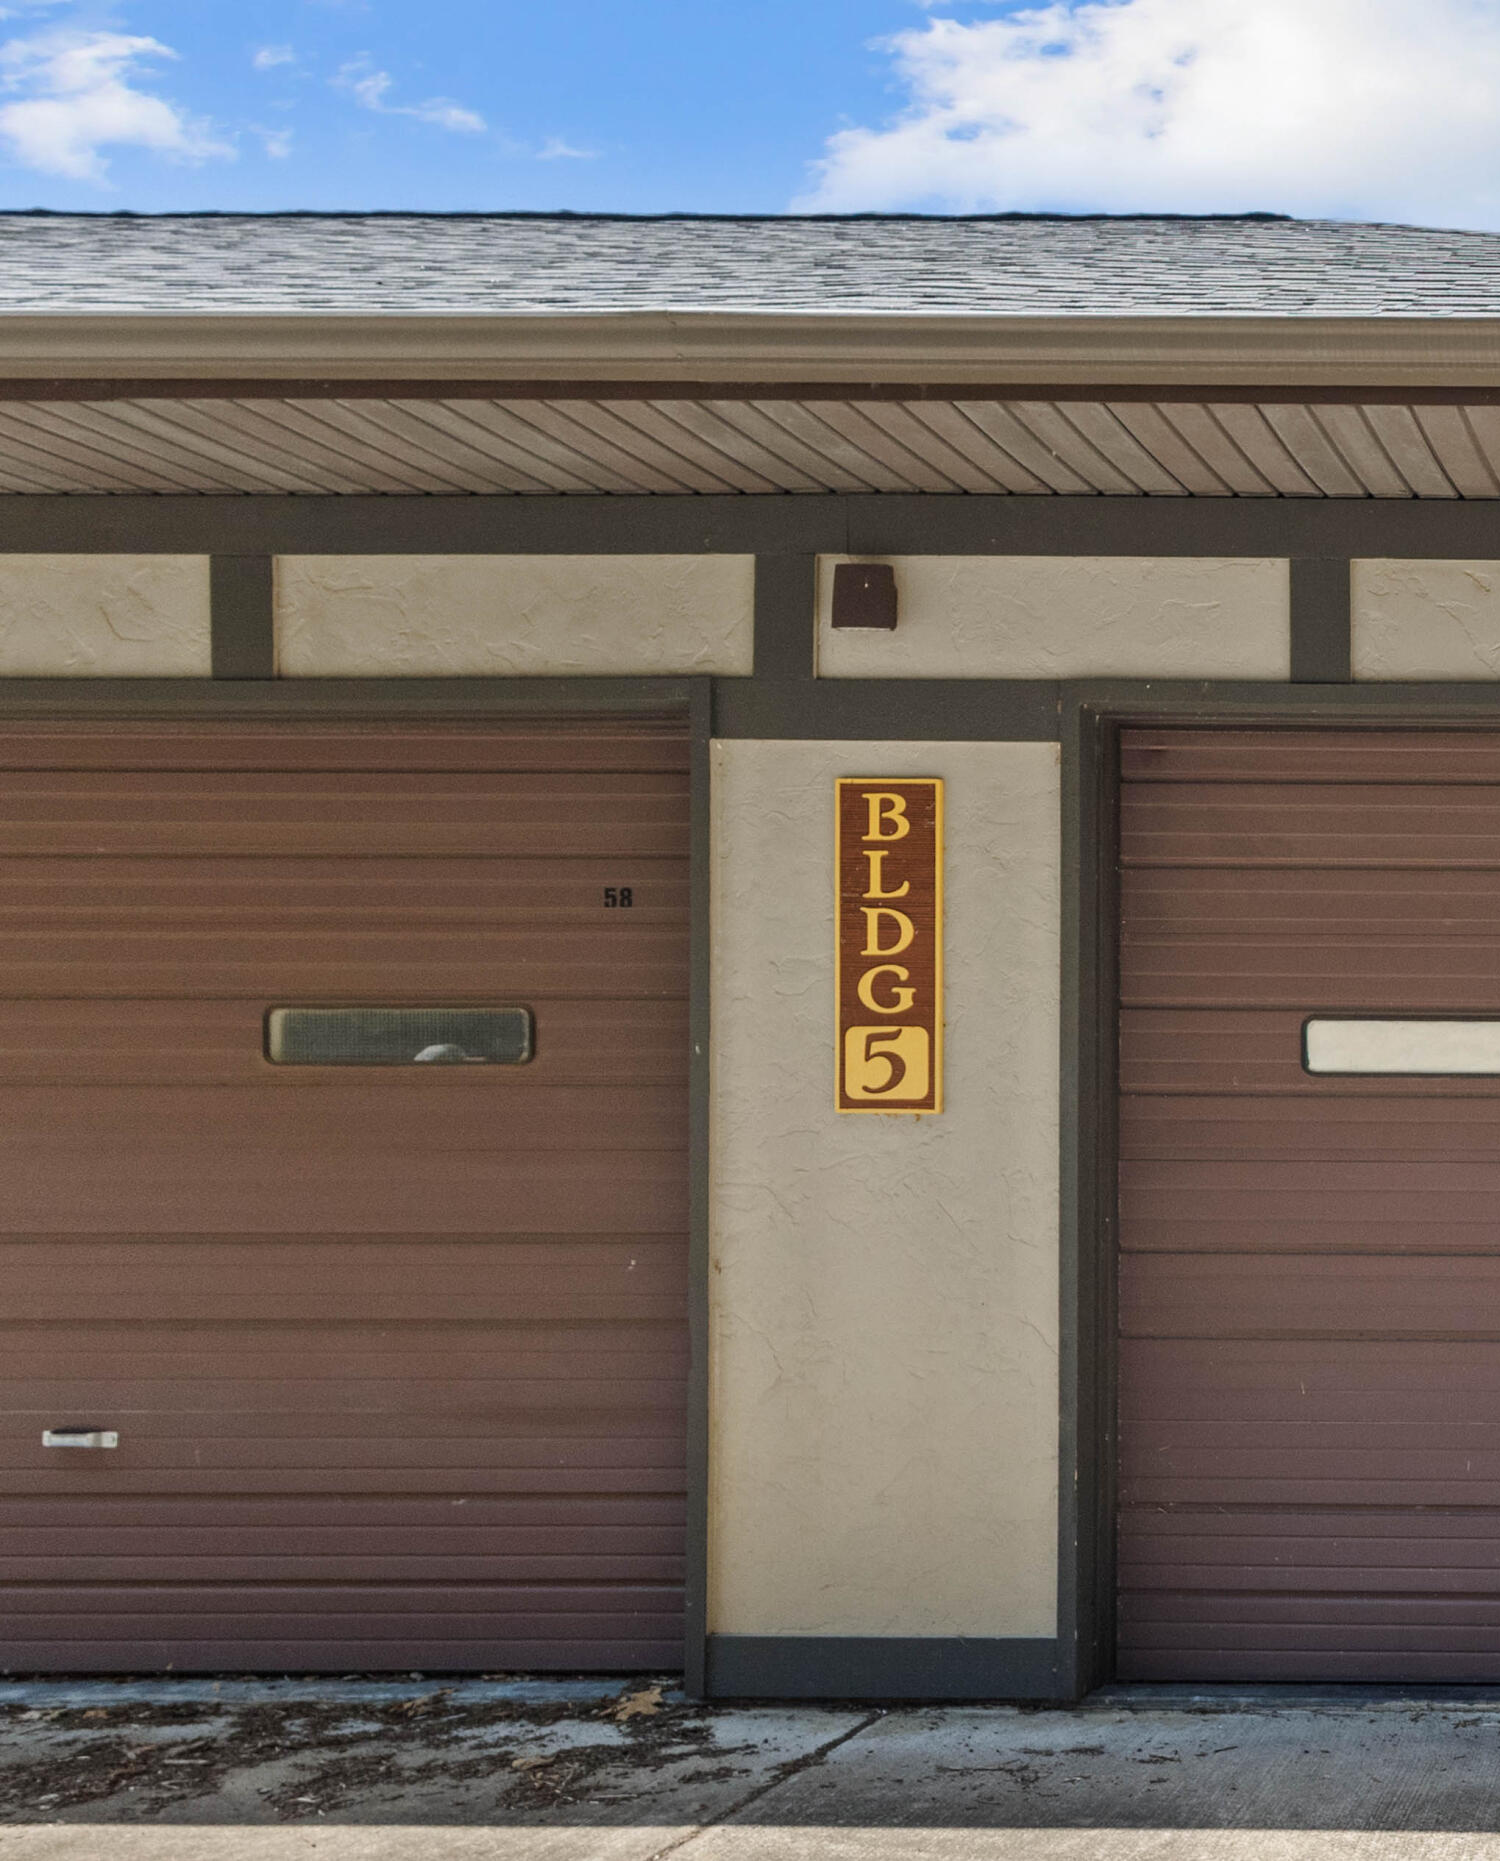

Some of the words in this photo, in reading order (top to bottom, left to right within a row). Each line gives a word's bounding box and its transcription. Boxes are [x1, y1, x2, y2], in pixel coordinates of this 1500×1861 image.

[603, 887, 633, 908] 58
[857, 792, 917, 1014] BLDG
[862, 1028, 907, 1094] 5
